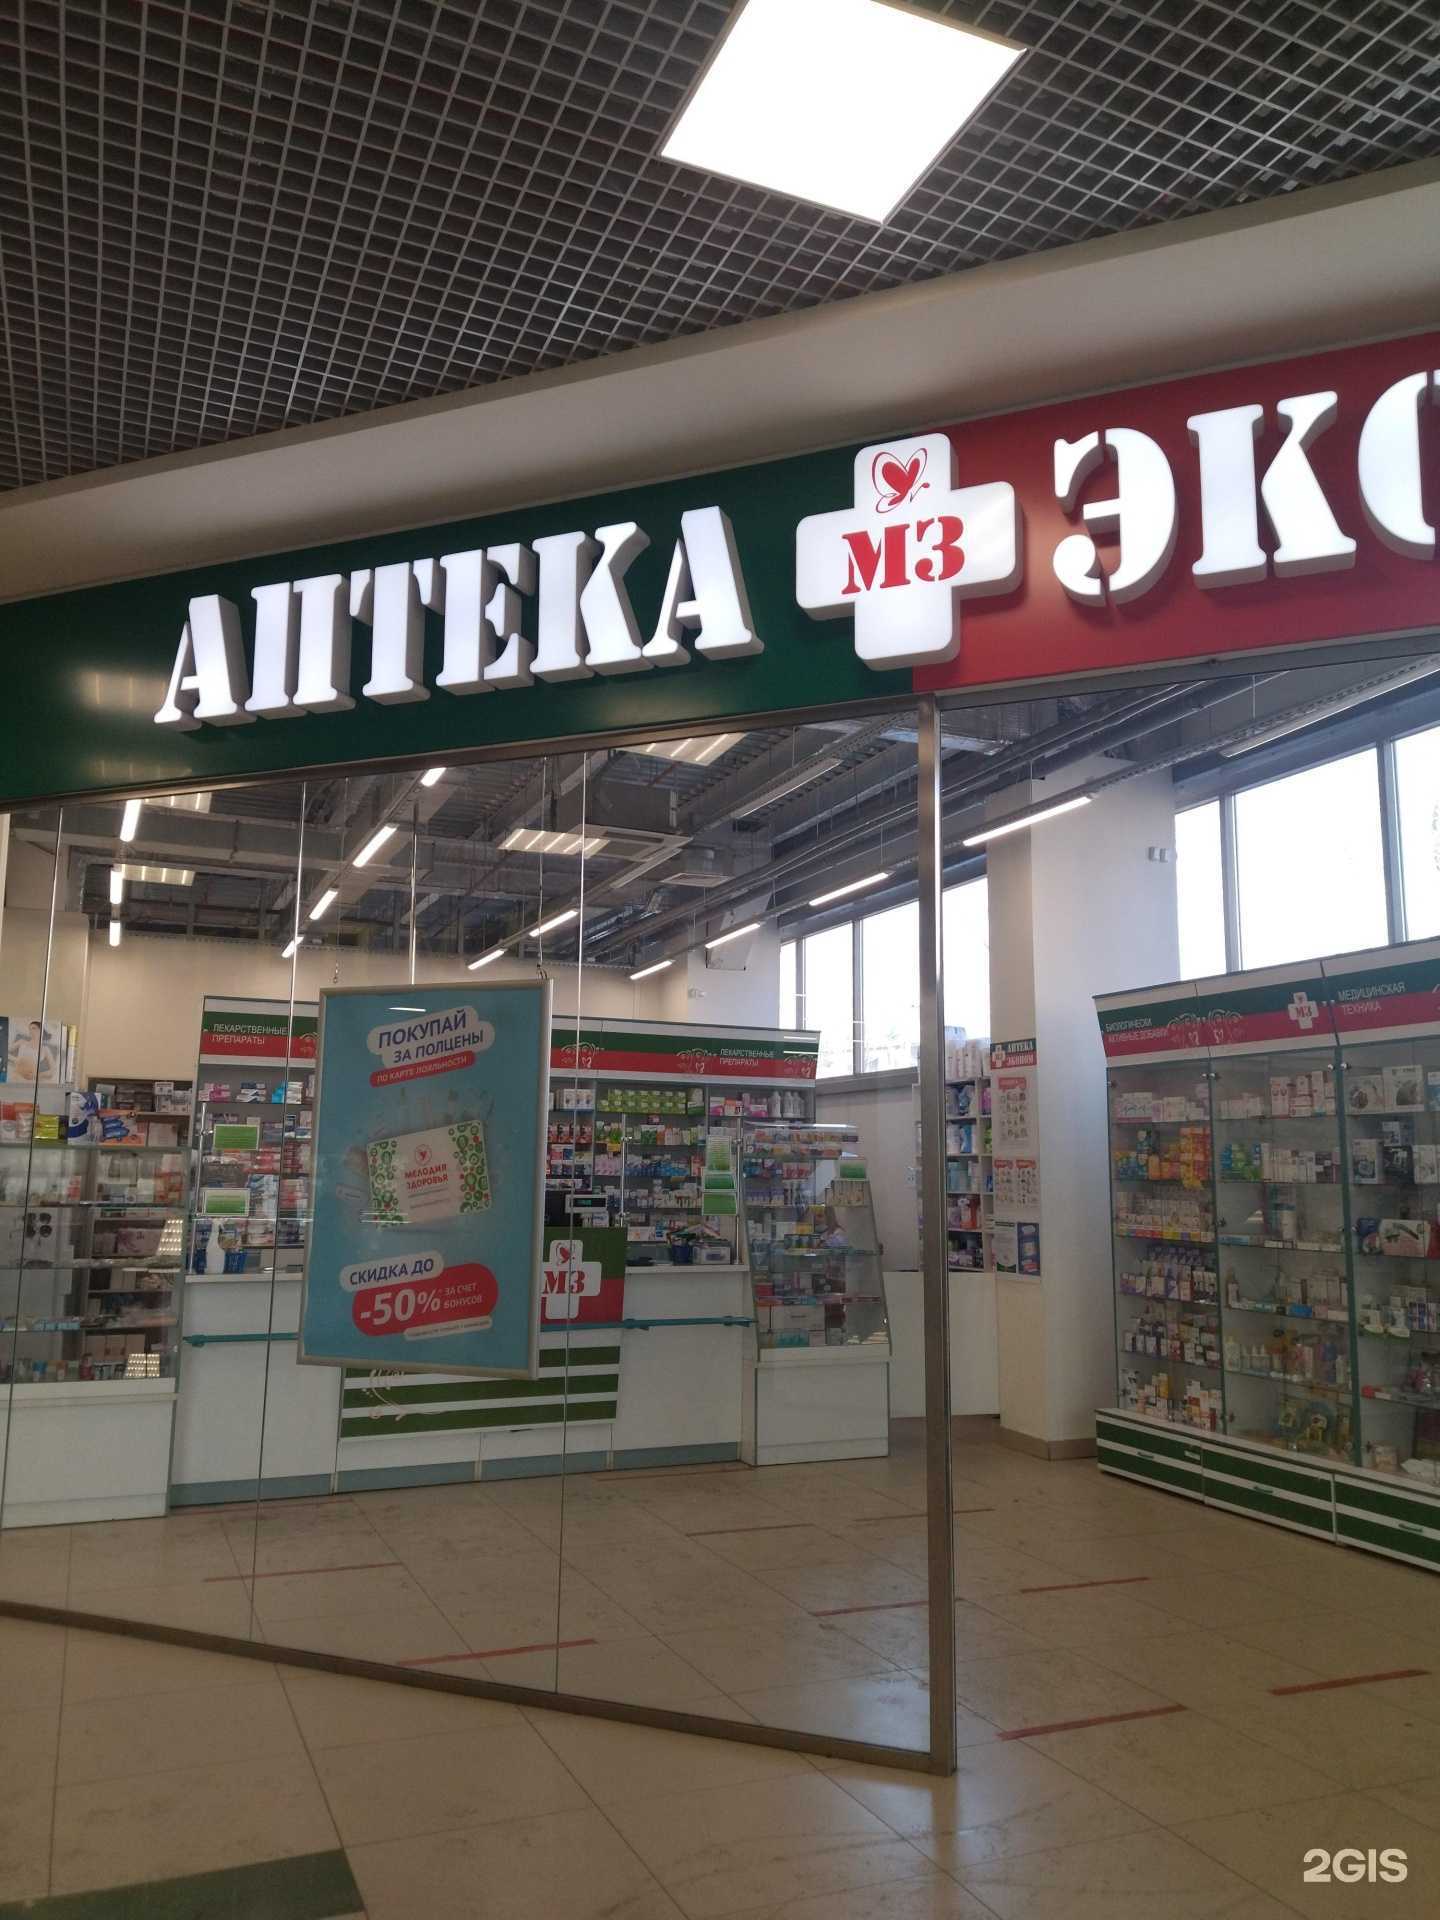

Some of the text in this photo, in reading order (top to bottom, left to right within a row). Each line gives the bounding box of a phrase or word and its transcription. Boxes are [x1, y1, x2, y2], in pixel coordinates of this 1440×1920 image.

[153, 504, 760, 728] АПТЕКА
[1338, 981, 1406, 1001] МЕДИЦИНСКАЯ
[1341, 1001, 1382, 1016] ТЕХНИКА
[213, 1023, 288, 1036] ЛЕКАРСТВЕННЫЕ
[378, 1008, 467, 1049] ПОКУПАЙ
[212, 1035, 265, 1046] ПРЕПАРАТЫ
[393, 1030, 484, 1064] ЗА ПОЛЦЕНЫ
[404, 1163, 447, 1179] МЕЛОДИЯ
[406, 1175, 449, 1190] ЗДОРОВЬЯ
[349, 1258, 434, 1286] СКИДКА ДО
[360, 1287, 441, 1326] -50%
